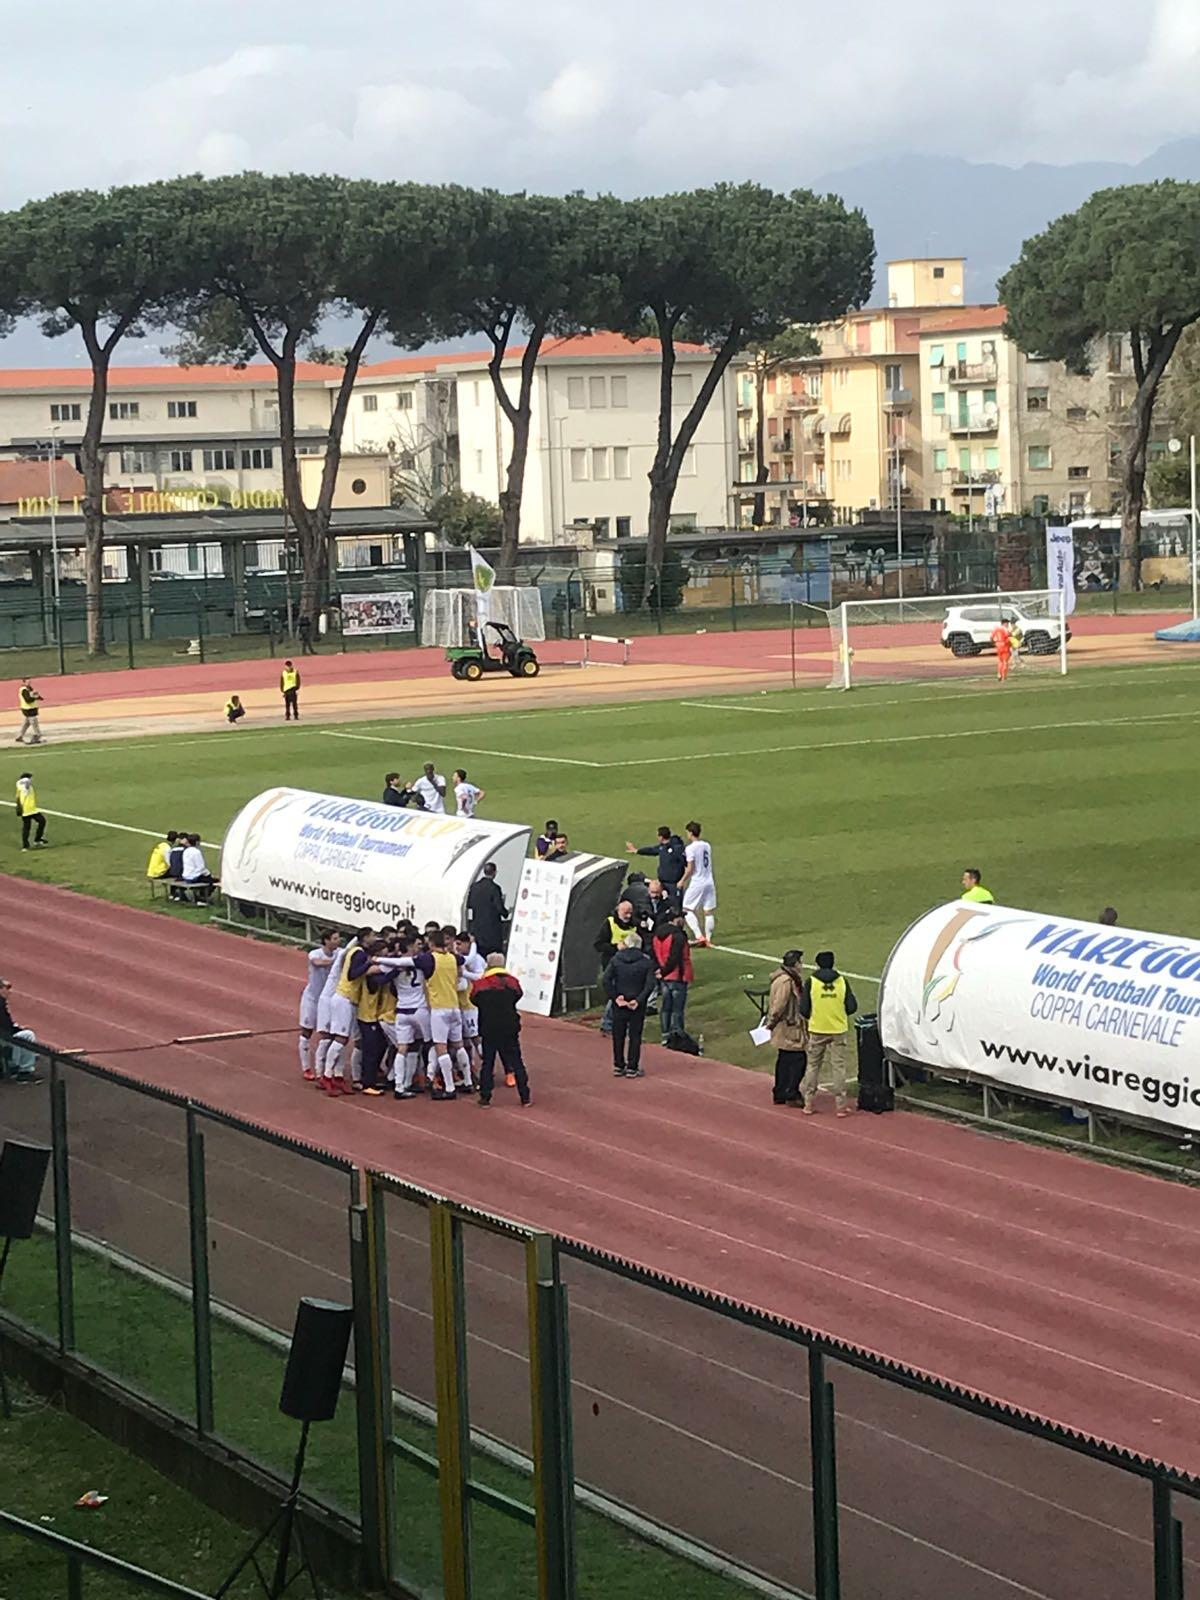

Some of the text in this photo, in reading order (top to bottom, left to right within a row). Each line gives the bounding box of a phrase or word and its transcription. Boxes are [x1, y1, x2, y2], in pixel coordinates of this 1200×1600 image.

[1050, 532, 1072, 544] Jeep
[304, 799, 413, 833] VIAREGGIO
[293, 841, 369, 873] COPPA CARNEVALE
[299, 823, 414, 858] World Football Tournament
[703, 850, 710, 869] 6
[268, 875, 416, 921] www.viareggiocup.it
[1025, 923, 1200, 982] VIAREGG
[410, 966, 421, 988] 2
[1031, 962, 1087, 993] World
[1082, 972, 1162, 1008] Football
[1030, 991, 1186, 1048] COPPA CARNEVALE
